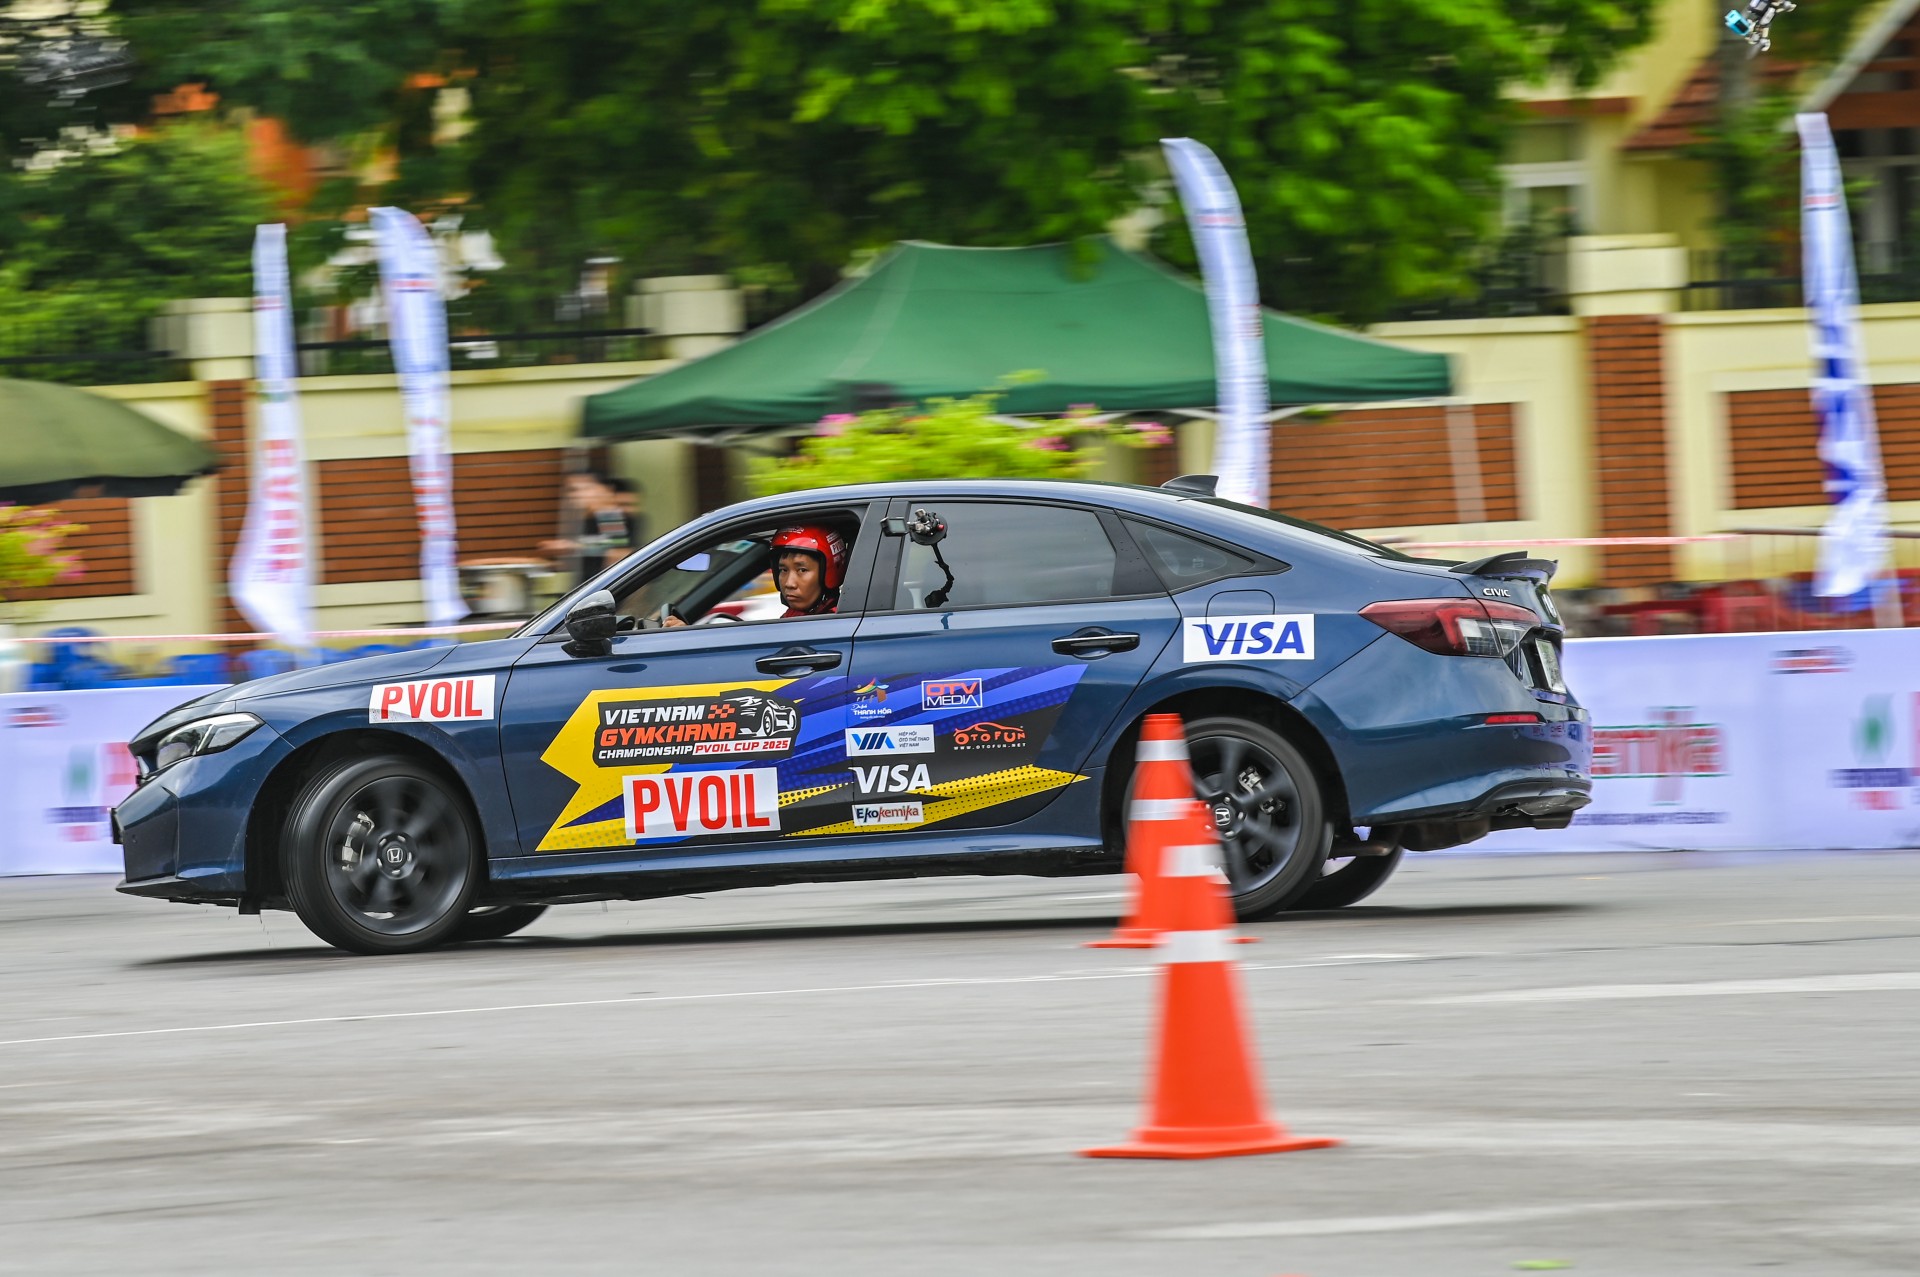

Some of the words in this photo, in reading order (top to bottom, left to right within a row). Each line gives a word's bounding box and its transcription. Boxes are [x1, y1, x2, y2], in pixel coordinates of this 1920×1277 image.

[1483, 588, 1511, 597] CIVIC
[1192, 621, 1305, 656] VISA
[926, 681, 979, 697] OTV
[381, 680, 483, 720] PVOIL
[926, 694, 980, 706] MEDIA
[605, 704, 705, 726] VIETNAM
[600, 721, 737, 747] GYMKHANA
[954, 731, 1026, 746] OTOFUN
[598, 746, 694, 760] CHAMPIONSHIP
[695, 743, 731, 754] PVOIL
[733, 741, 760, 752] CUP
[762, 739, 789, 749] 2025
[848, 763, 932, 794] VISA
[632, 773, 770, 834] PVOIL
[856, 805, 919, 823] Ekokemika
